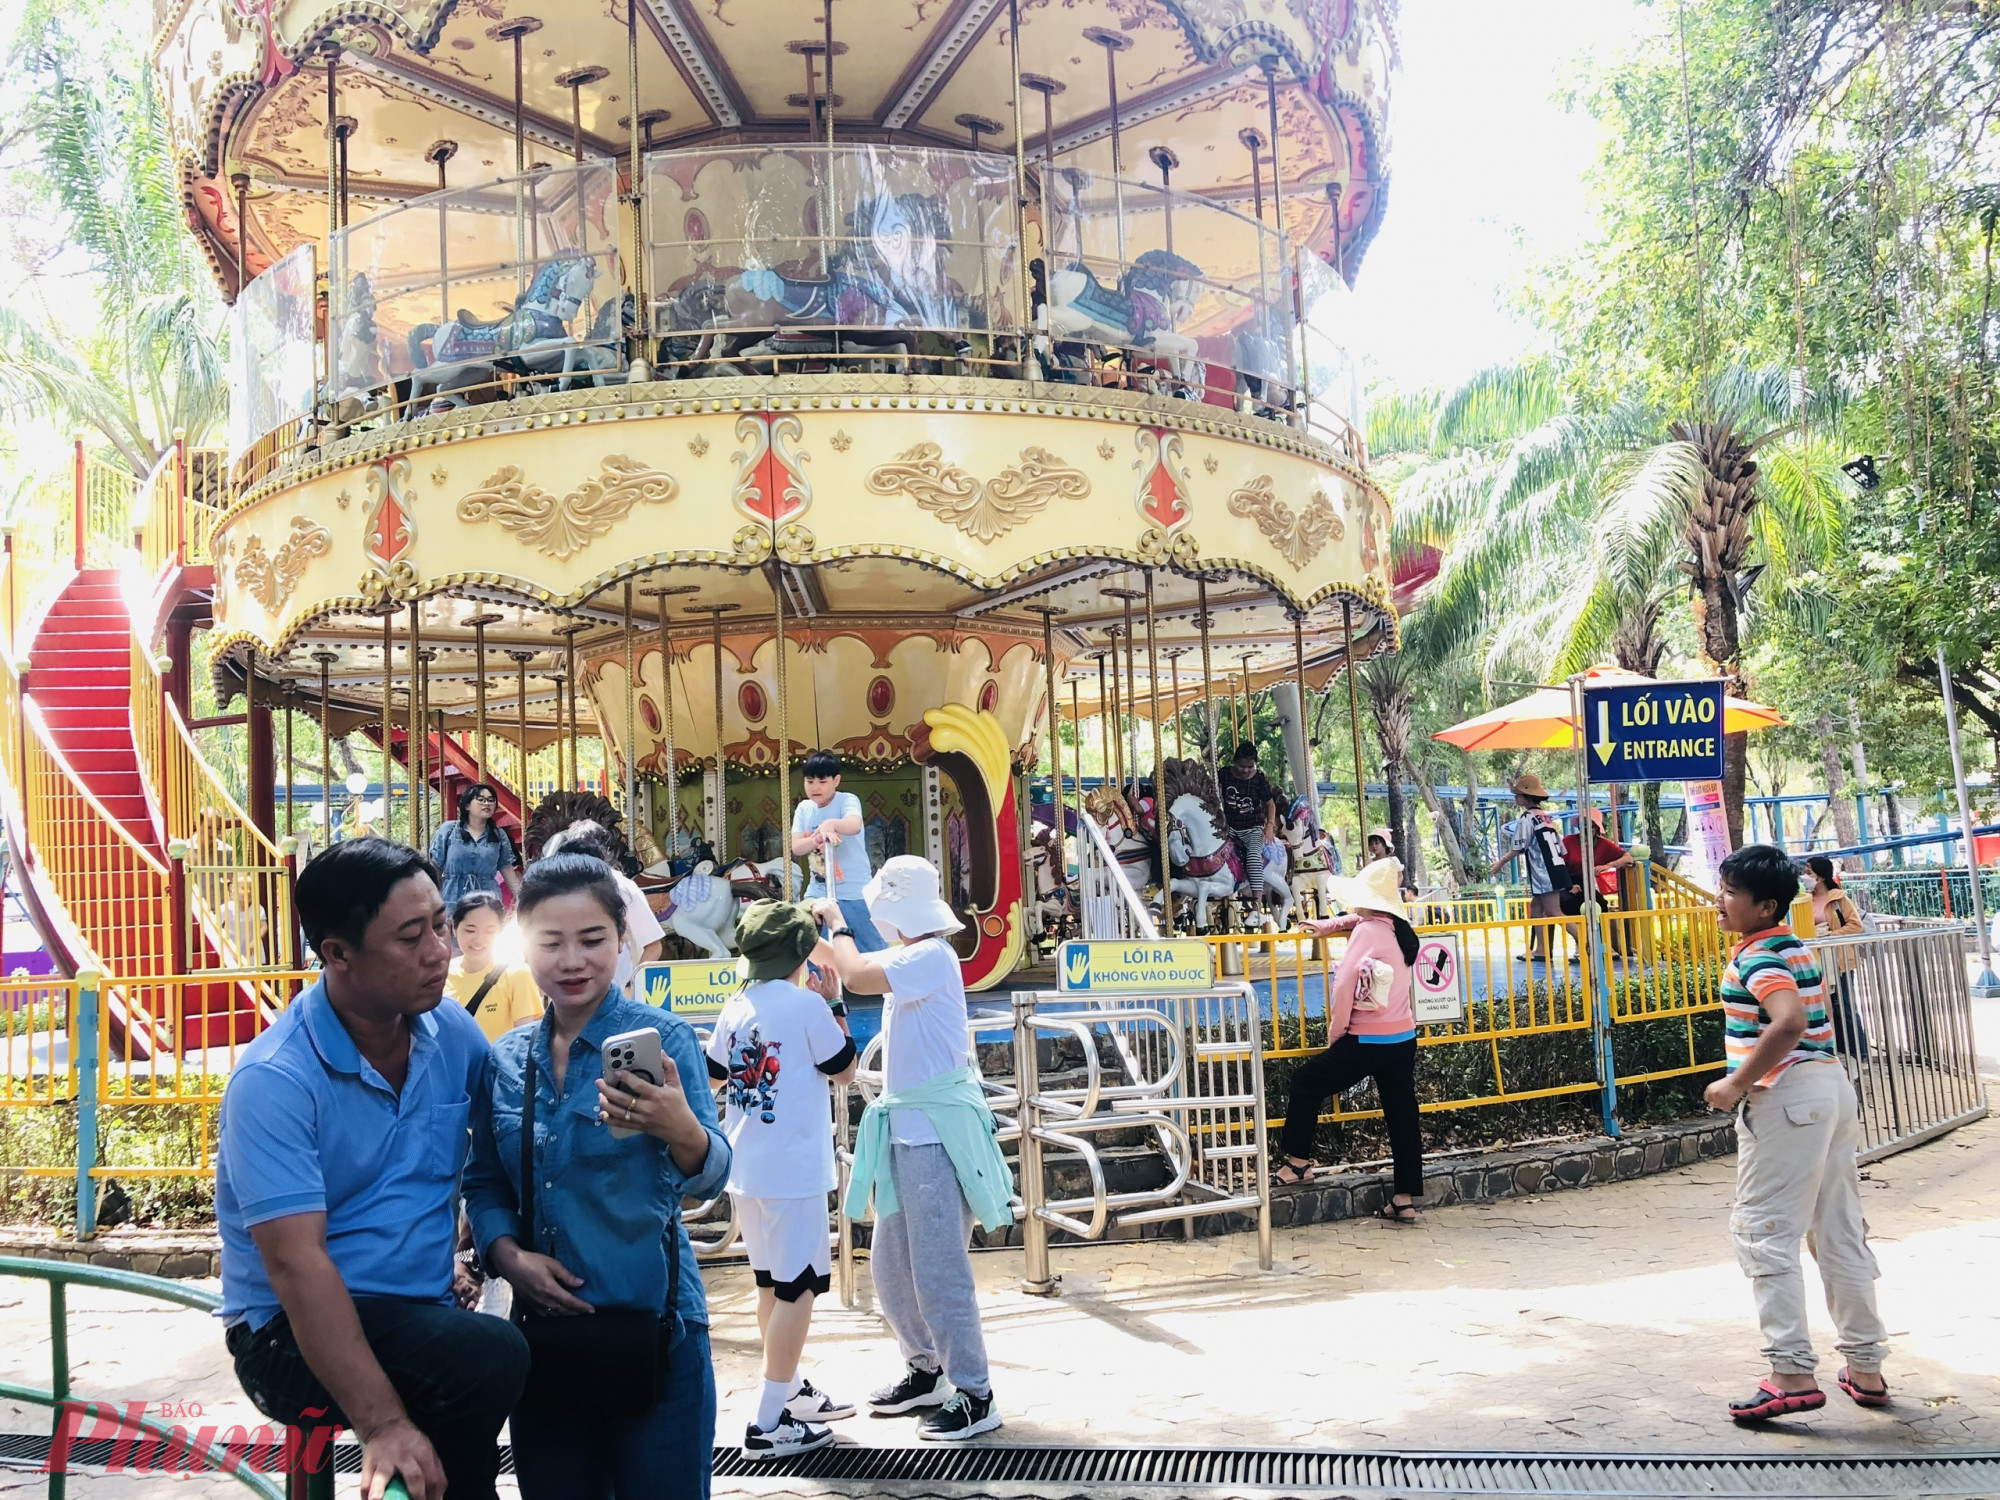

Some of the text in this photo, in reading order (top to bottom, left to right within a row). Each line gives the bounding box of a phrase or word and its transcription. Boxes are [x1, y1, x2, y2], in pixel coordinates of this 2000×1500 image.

[1622, 693, 1715, 726] LỐI VÀO
[1623, 737, 1715, 760] ENTRANCE
[1123, 946, 1174, 964] LỐI RA
[709, 966, 736, 986] LỐI
[1093, 968, 1205, 983] KHÔNG VÀO ĐƯỢC
[675, 991, 725, 1006] KHÔNG
